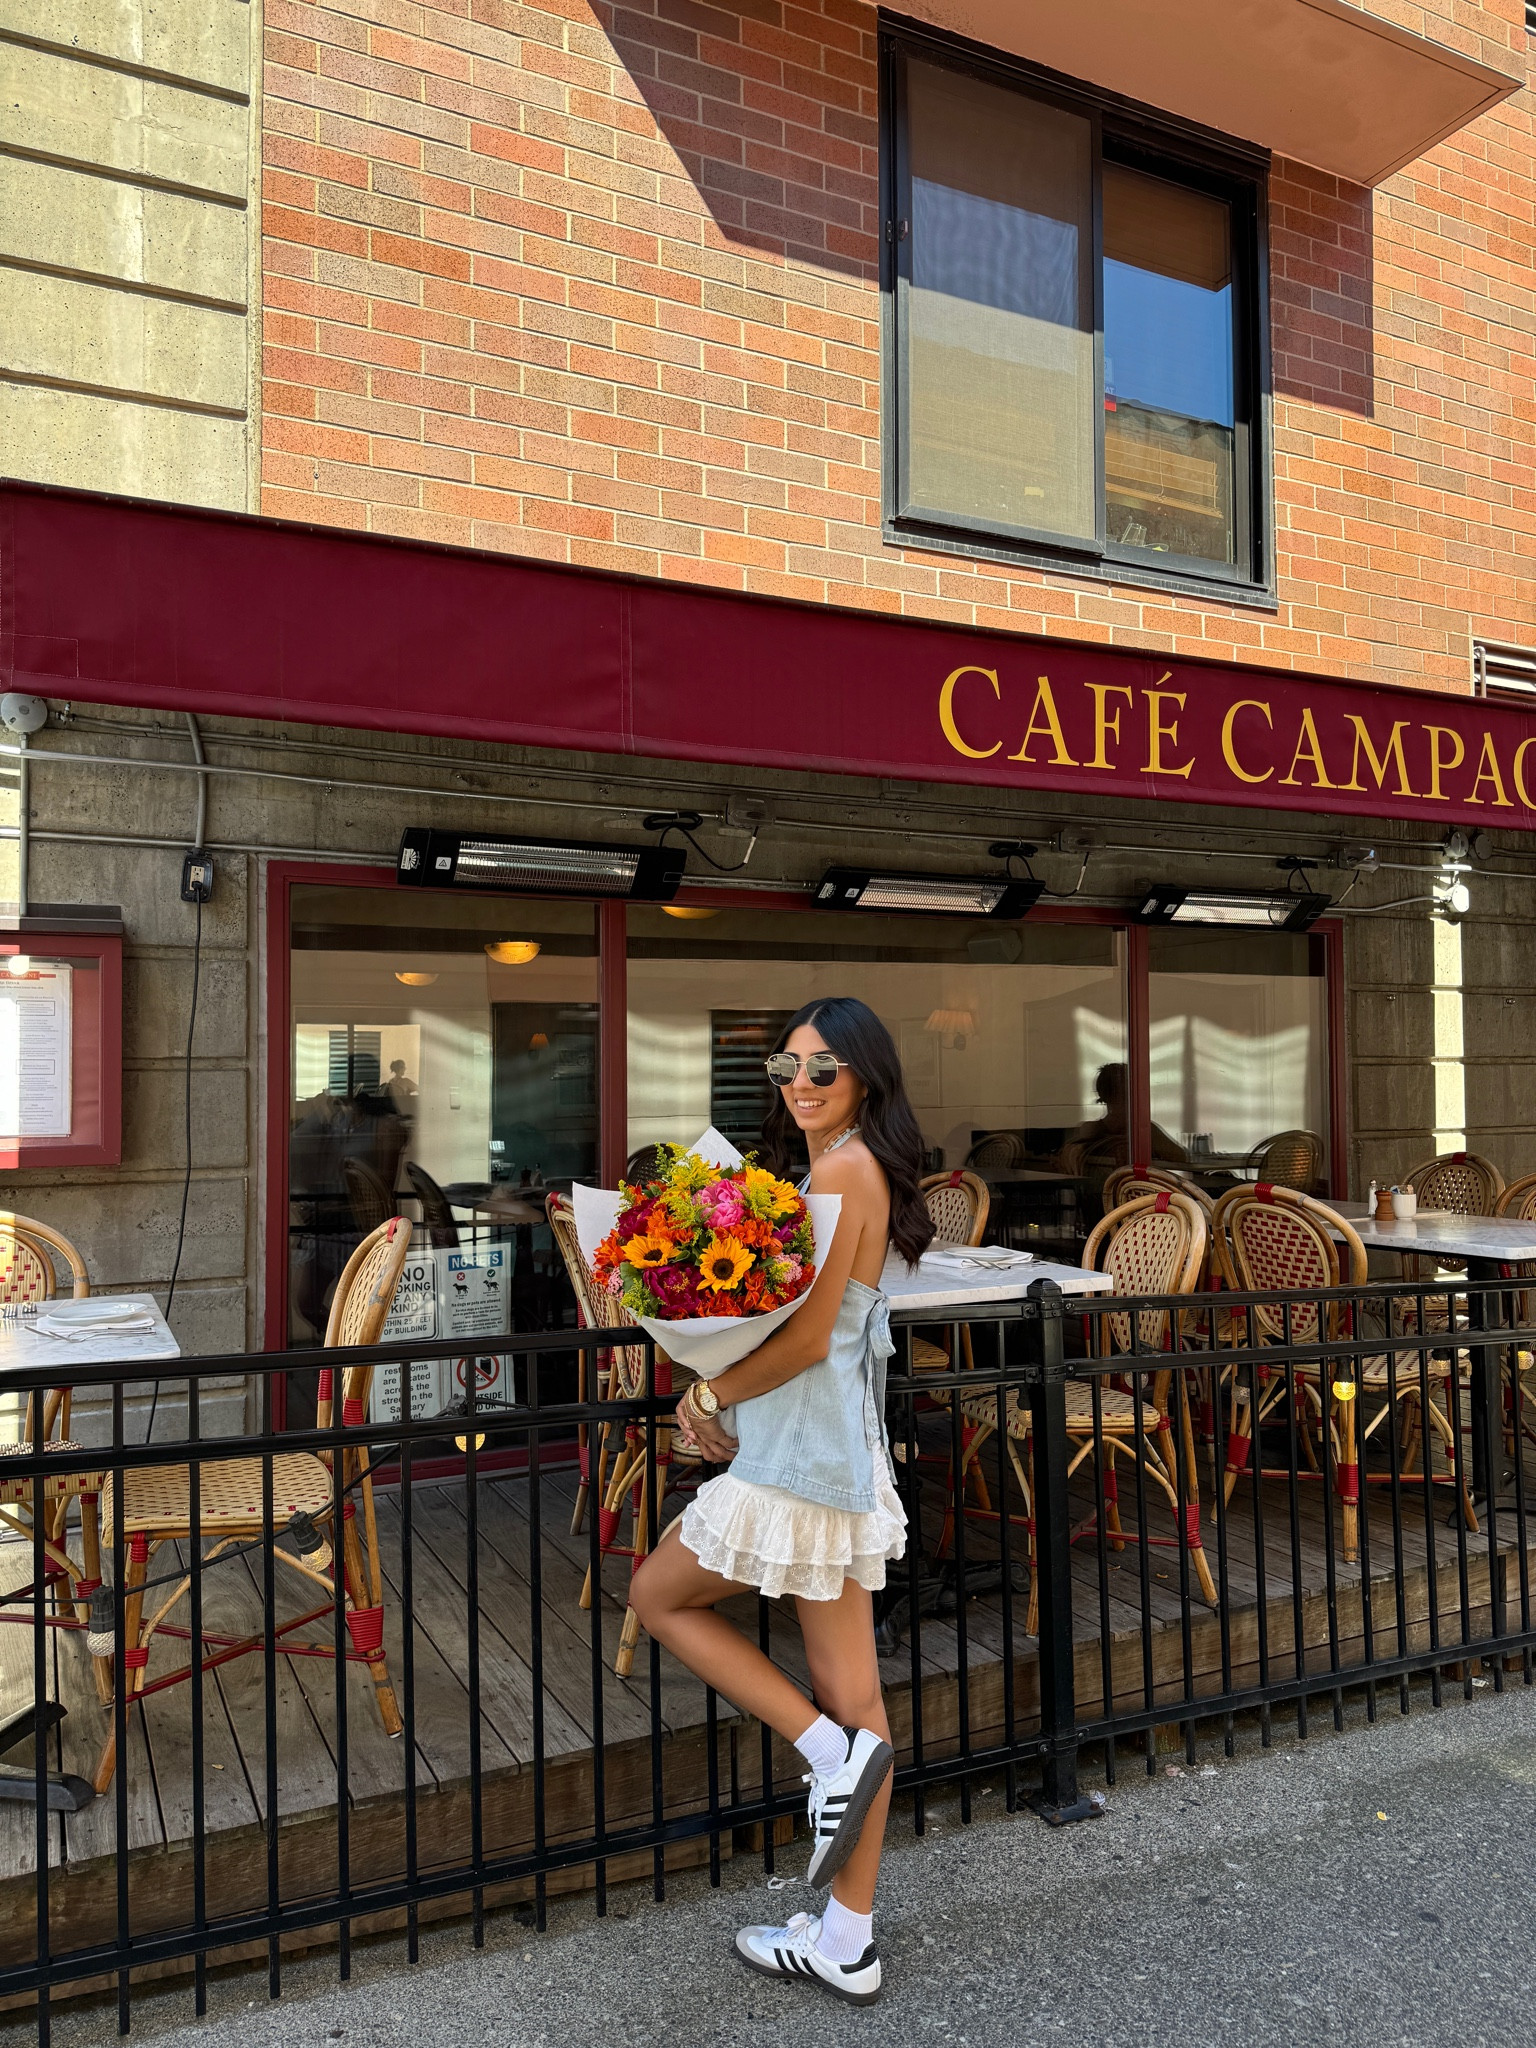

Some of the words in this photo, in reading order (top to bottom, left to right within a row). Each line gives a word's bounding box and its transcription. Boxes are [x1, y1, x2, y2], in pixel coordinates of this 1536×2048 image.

[939, 665, 1196, 780] CAFÉ
[452, 1254, 468, 1269] NO
[472, 1253, 500, 1267] PETS
[399, 1267, 425, 1283] NO
[396, 1281, 431, 1295] OKING
[393, 1295, 401, 1305] F
[404, 1292, 427, 1304] ANY
[391, 1302, 419, 1315] KIND
[384, 1319, 402, 1328] THIN
[404, 1318, 413, 1326] 25
[415, 1315, 432, 1324] FEET
[383, 1328, 393, 1336] OF
[395, 1325, 427, 1336] BUILDING
[384, 1364, 429, 1376] restoms
[383, 1377, 397, 1386] are
[384, 1386, 414, 1395] acrs
[416, 1383, 430, 1391] the
[381, 1397, 401, 1406] stre
[419, 1392, 433, 1400] the
[477, 1391, 503, 1401] TSIDE
[389, 1403, 426, 1414] Saary
